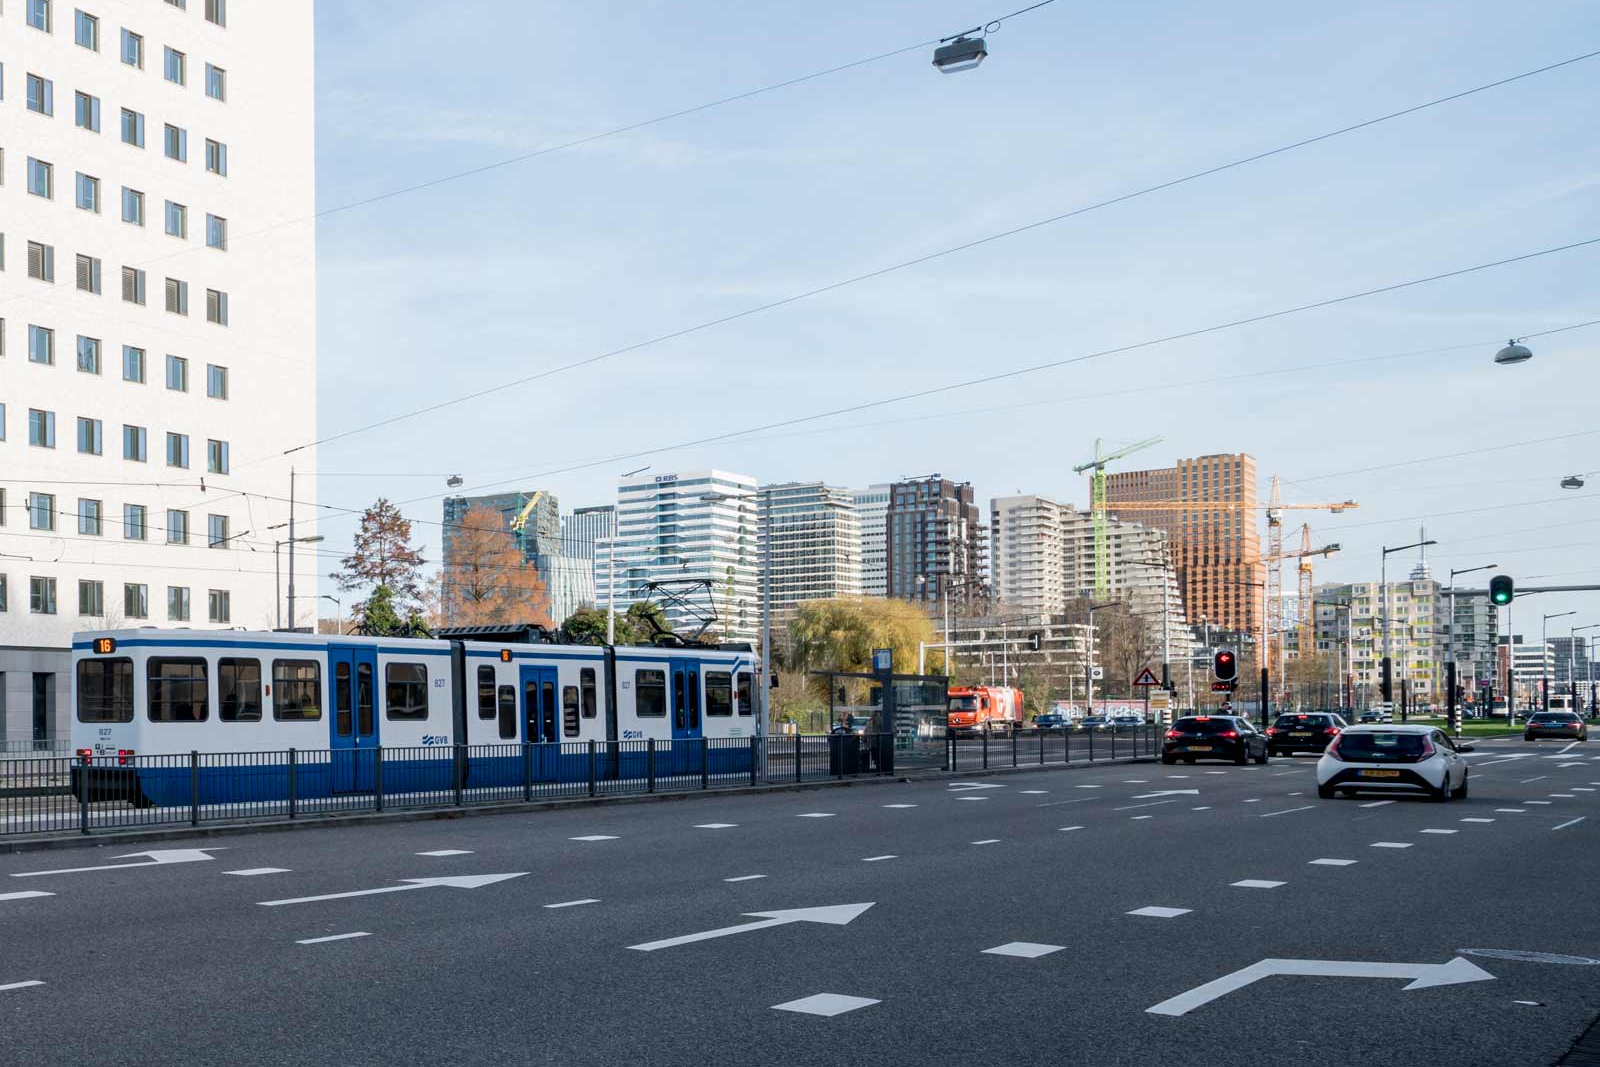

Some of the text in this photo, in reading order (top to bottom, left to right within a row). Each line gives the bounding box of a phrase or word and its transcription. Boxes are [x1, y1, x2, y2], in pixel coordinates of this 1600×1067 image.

[100, 639, 111, 653] 16
[435, 679, 445, 687] 827
[434, 736, 448, 744] GVB
